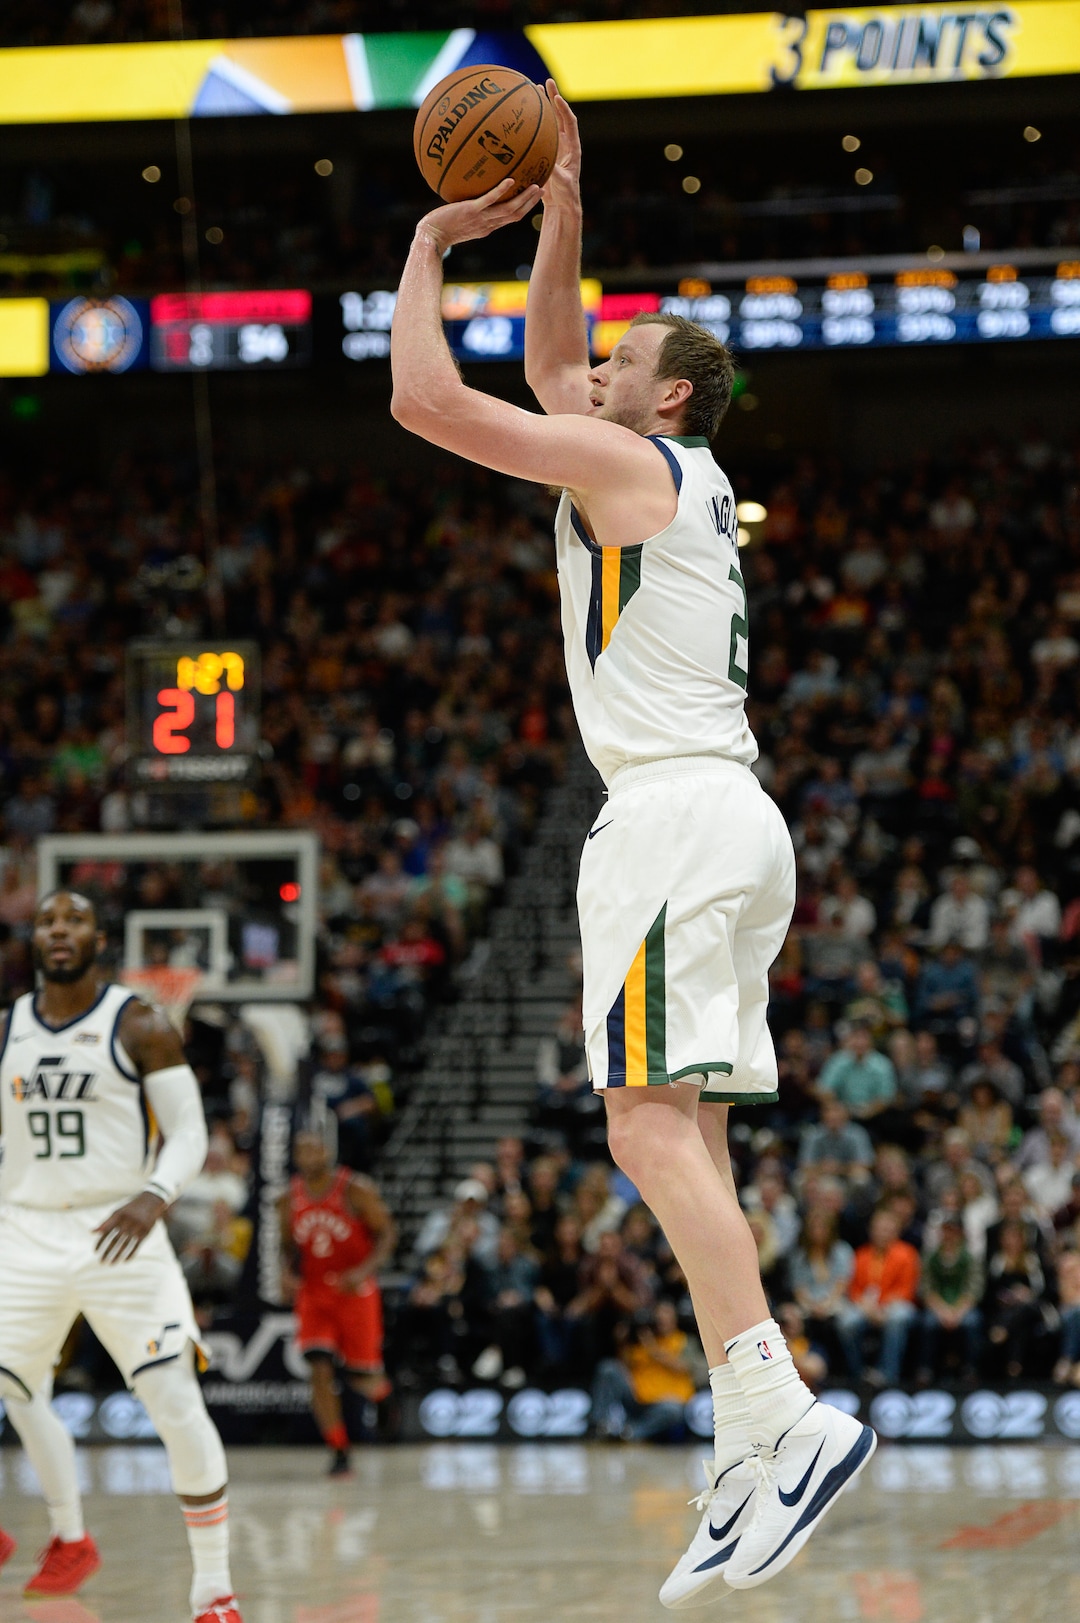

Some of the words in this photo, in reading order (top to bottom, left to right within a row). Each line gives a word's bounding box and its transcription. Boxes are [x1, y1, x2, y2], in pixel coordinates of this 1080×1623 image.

[770, 16, 806, 88] 3
[821, 11, 1013, 73] POINTS
[427, 78, 502, 167] SPALDING
[153, 688, 235, 754] 21
[11, 1057, 98, 1102] JAZZ
[28, 1110, 85, 1160] 99
